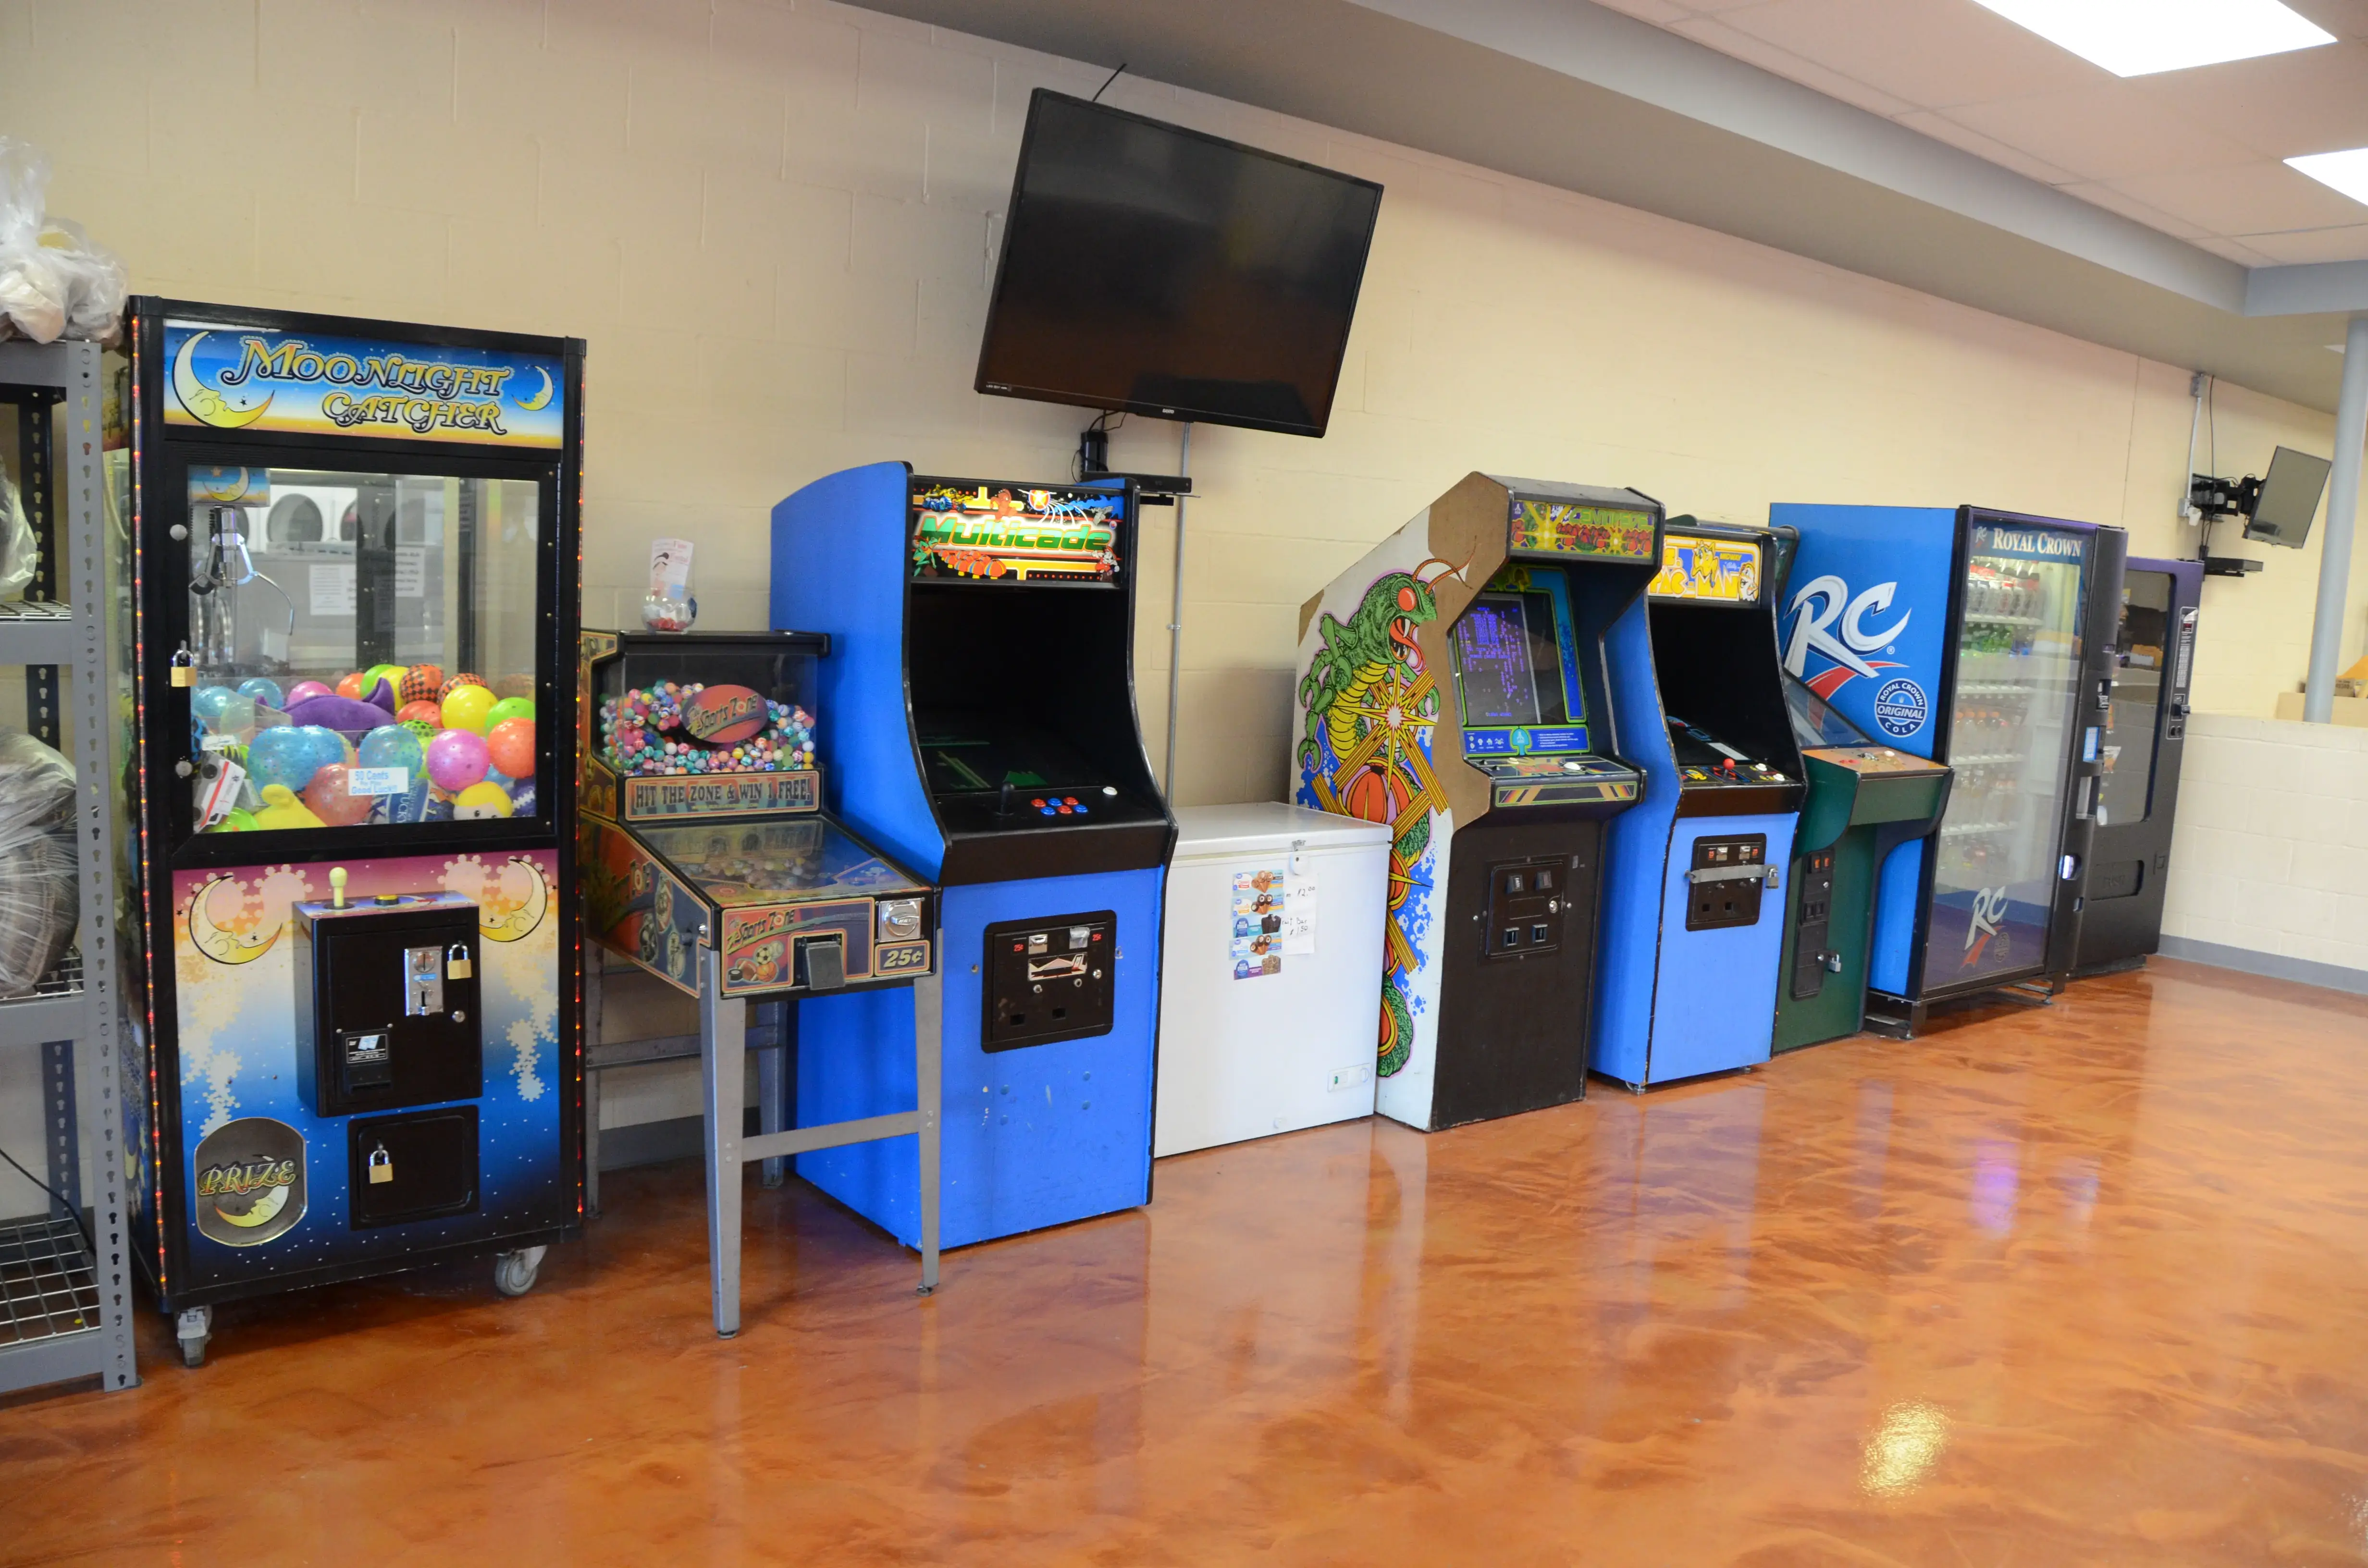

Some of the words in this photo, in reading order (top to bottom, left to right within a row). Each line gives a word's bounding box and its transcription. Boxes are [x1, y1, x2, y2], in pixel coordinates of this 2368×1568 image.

[221, 339, 510, 398] MOONLIGHT
[323, 393, 507, 435] CATCHER
[914, 515, 1111, 551] Multicade
[1568, 506, 1654, 530] CENTIPEDE
[1992, 527, 2035, 552] ROYAL
[2037, 532, 2083, 557] CROWN
[1782, 575, 1912, 678] RC
[1880, 683, 1900, 701] ROYAL
[1901, 683, 1924, 706] CROWN
[1877, 705, 1923, 719] ORIGINAL
[1885, 722, 1916, 733] COLA
[636, 785, 657, 808] HIT
[662, 785, 685, 805] THE
[690, 784, 721, 802] ZONE
[727, 784, 735, 800] &
[739, 783, 763, 800] WIN
[767, 782, 773, 799] 1
[778, 778, 812, 801] FREE!
[1964, 886, 2008, 951] RC
[883, 949, 923, 968] 25¢
[199, 1160, 296, 1196] PRIZE
